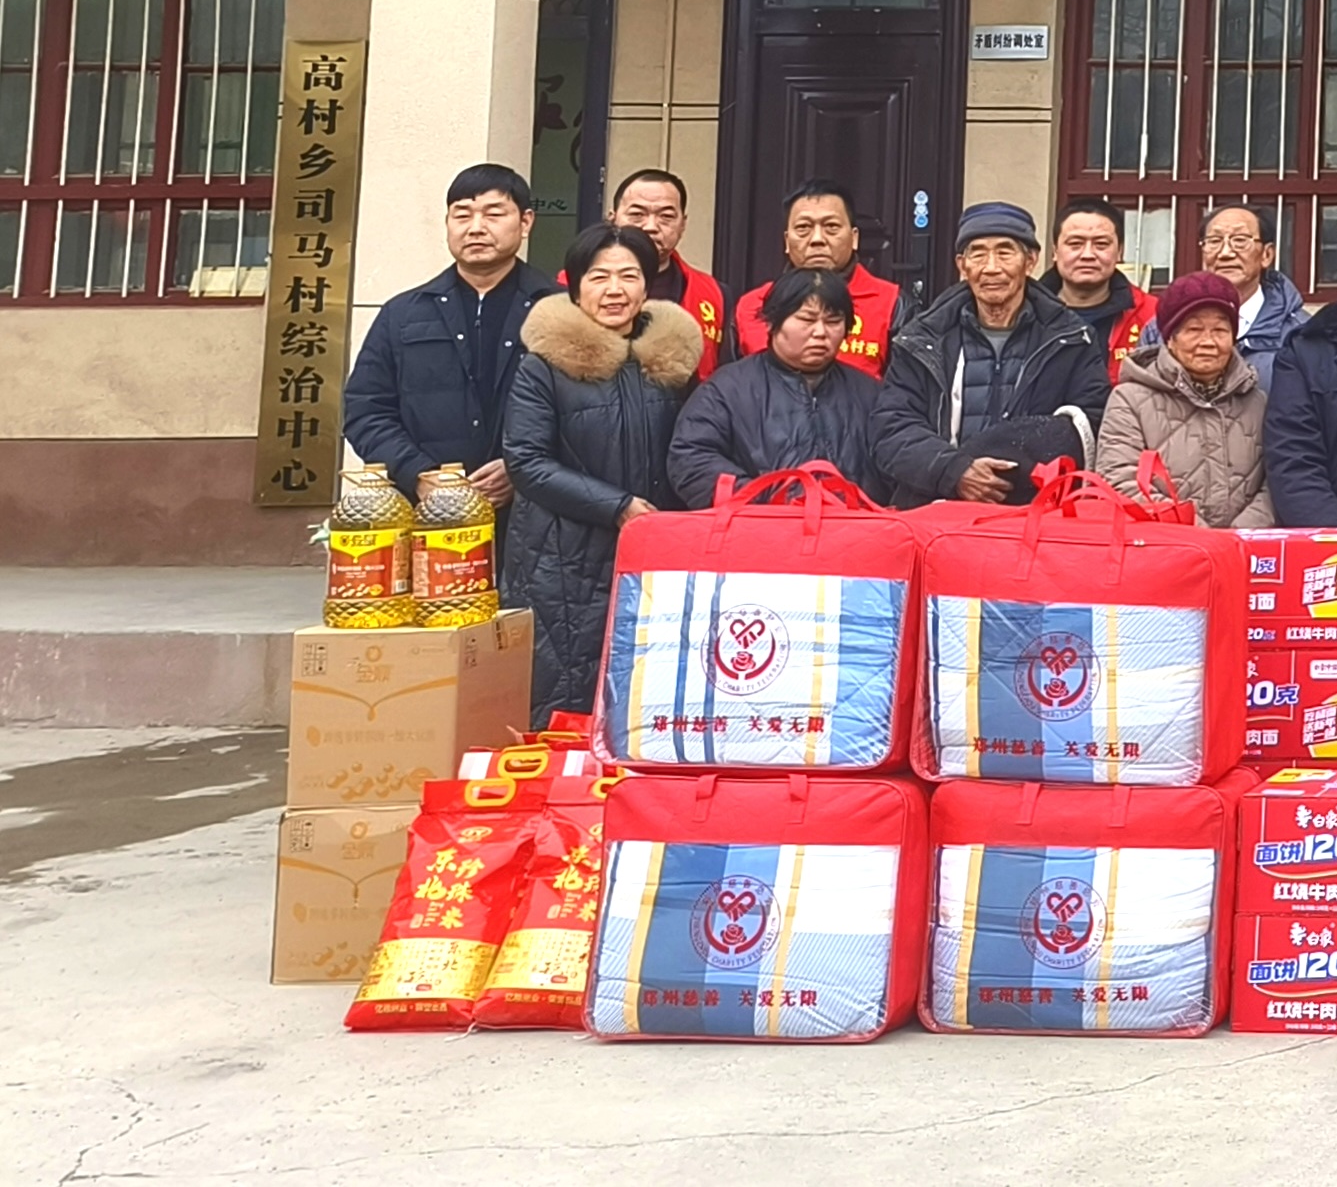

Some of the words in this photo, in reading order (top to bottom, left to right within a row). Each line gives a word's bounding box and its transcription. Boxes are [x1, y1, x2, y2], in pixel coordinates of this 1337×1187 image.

[975, 34, 1044, 49] 矛盾纠纷调处室
[271, 54, 347, 493] 高村乡司马村综治中心
[652, 715, 729, 732] 郑州慈善
[749, 715, 825, 732] 关爱无限
[972, 737, 1046, 756] 郑州慈善
[1064, 741, 1141, 758] 关爱无限
[642, 989, 720, 1007] 郑州慈善
[739, 990, 818, 1007] 关爱无限
[978, 986, 1054, 1004] 郑州慈善
[1071, 986, 1149, 1003] 关爱无限
